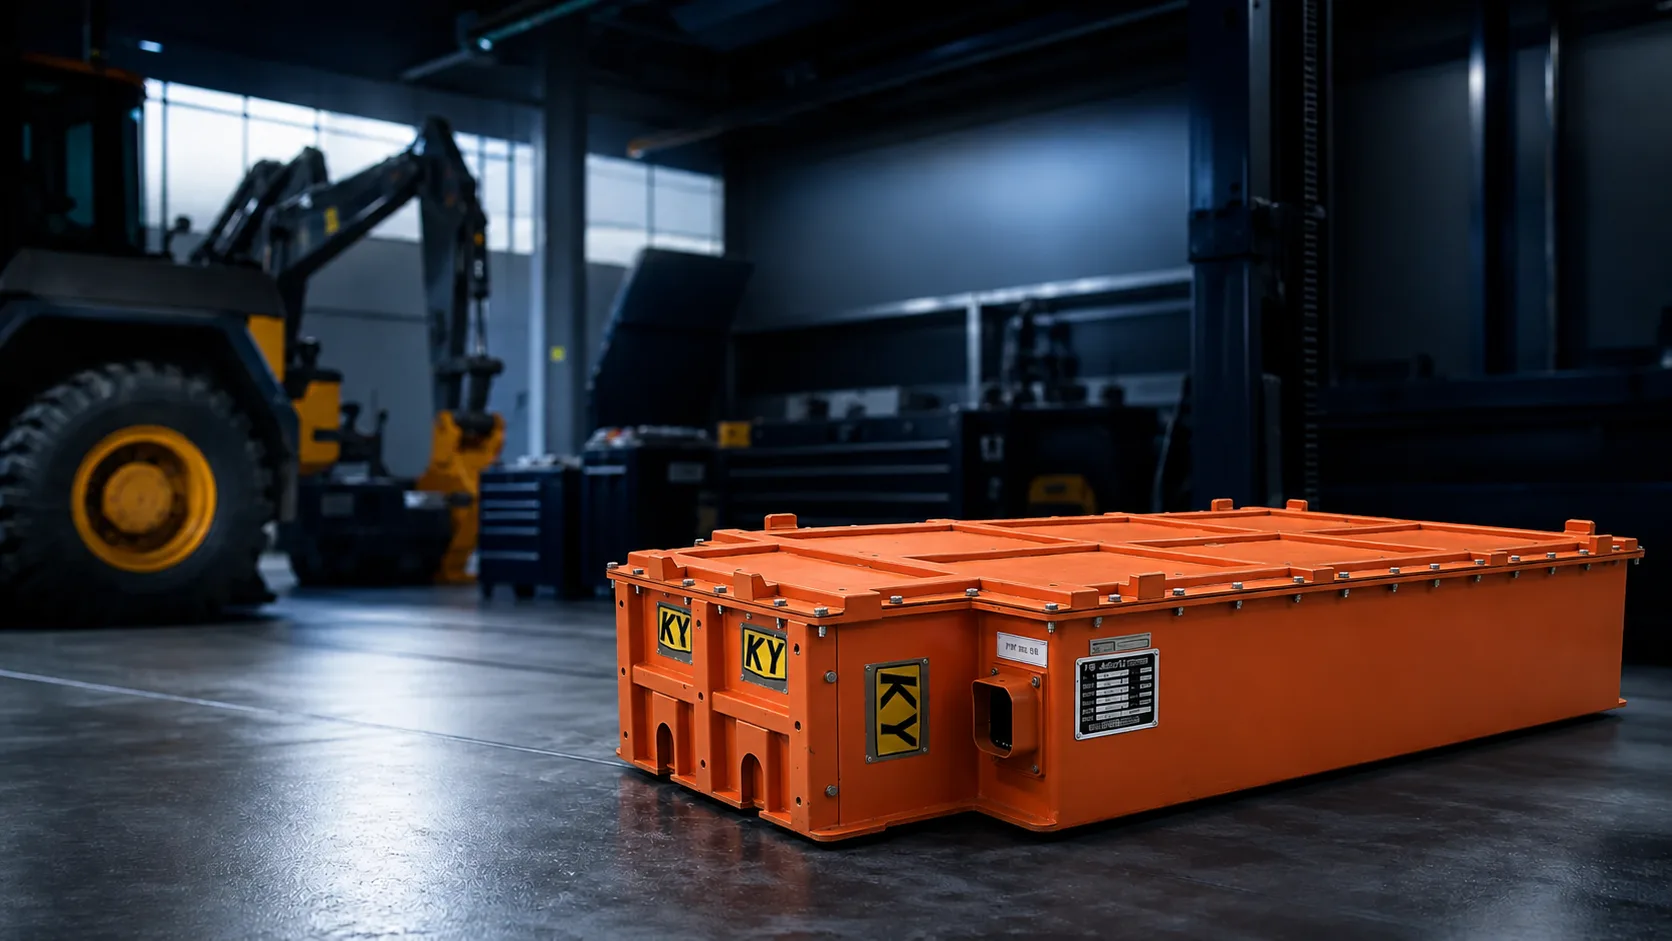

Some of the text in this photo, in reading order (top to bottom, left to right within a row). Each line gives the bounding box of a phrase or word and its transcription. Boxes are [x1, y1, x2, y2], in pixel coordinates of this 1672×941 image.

[660, 611, 690, 648] KY
[746, 634, 785, 675] KY
[880, 672, 917, 747] KY
